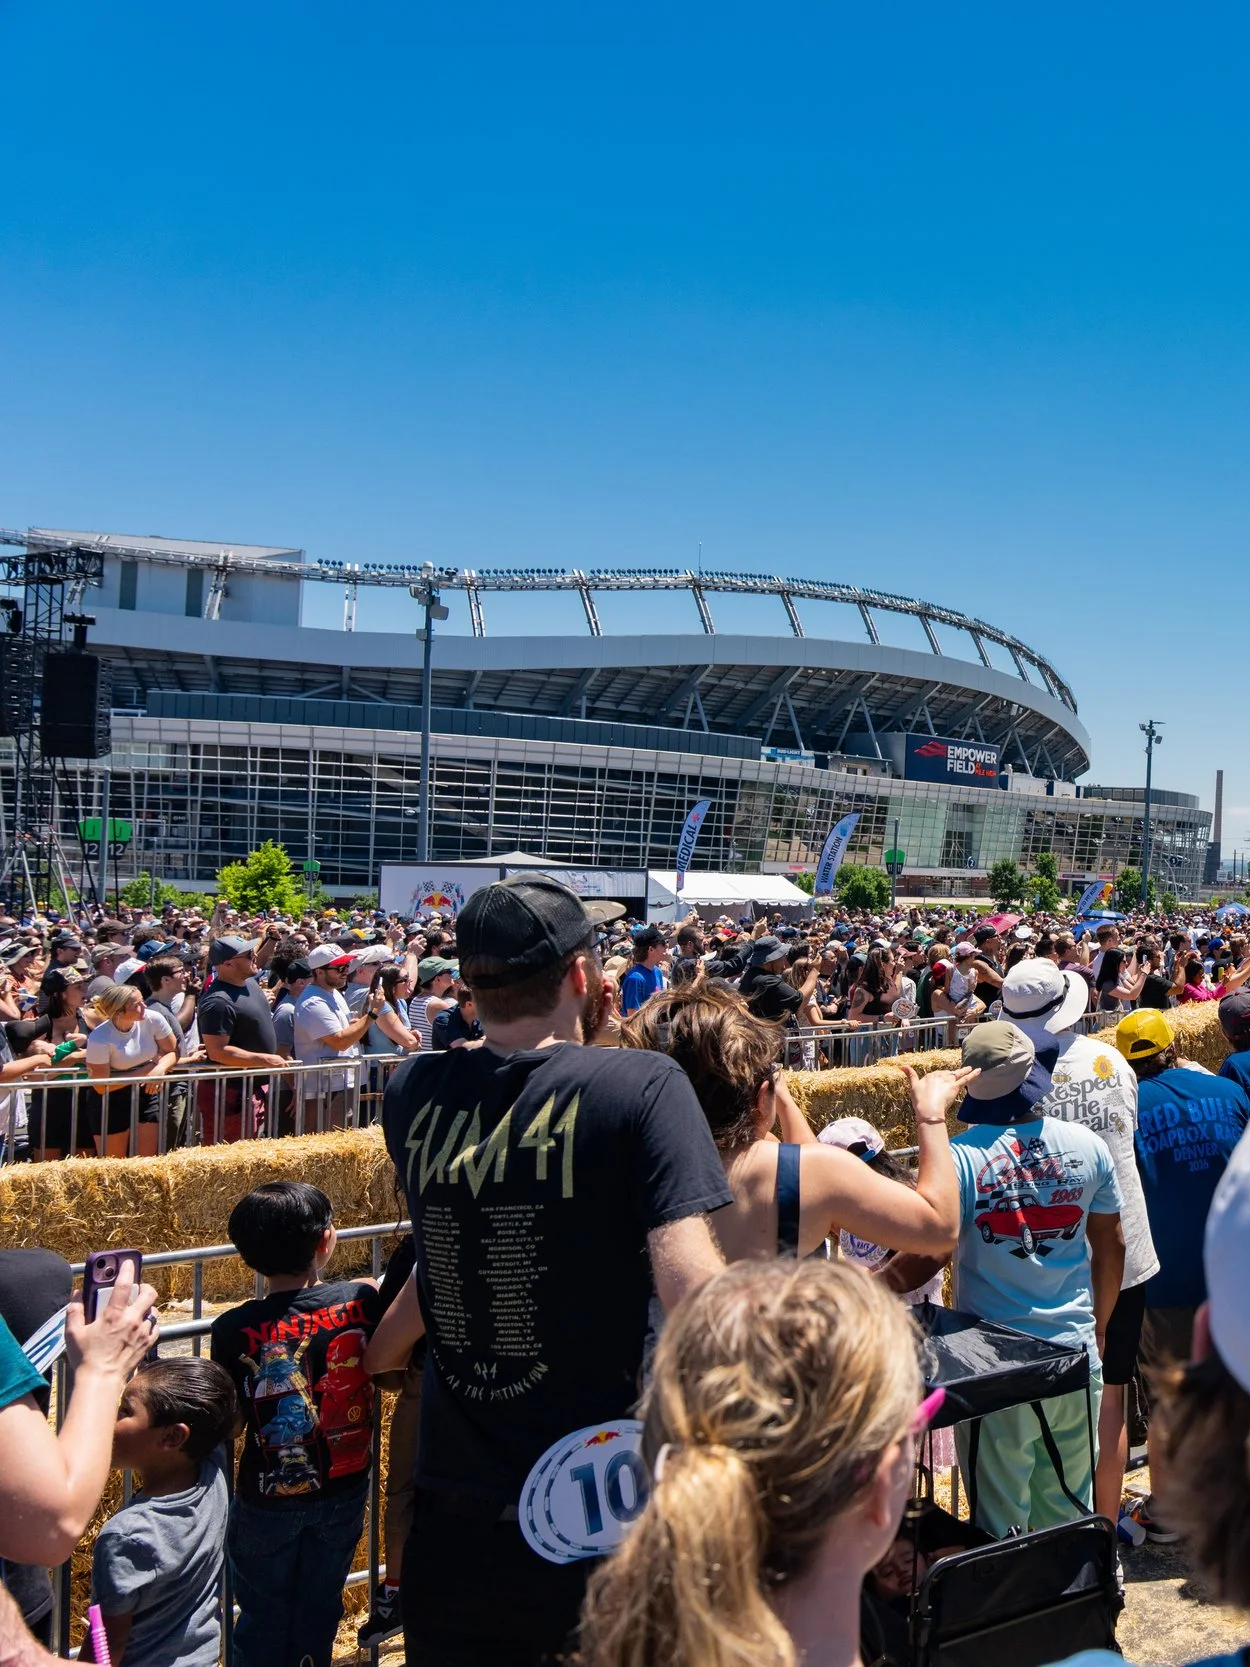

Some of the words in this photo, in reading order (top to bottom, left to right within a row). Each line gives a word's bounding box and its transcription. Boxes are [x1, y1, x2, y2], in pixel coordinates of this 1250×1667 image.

[946, 758, 976, 775] FIELD
[947, 745, 998, 765] EMPOWER
[84, 843, 99, 856] 12
[108, 843, 124, 856] 12
[677, 824, 698, 873] MEDICAL
[820, 860, 832, 884] WATER
[828, 836, 844, 863] STATION
[1049, 1098, 1101, 1122] The
[1139, 1102, 1180, 1138] RED
[405, 1095, 517, 1200] SUM
[518, 1088, 582, 1199] 41
[1137, 1123, 1210, 1157] SOAPBOX
[1173, 1142, 1219, 1162] DENVER
[1057, 1178, 1083, 1186] RAY
[856, 1240, 871, 1250] RACE
[240, 1301, 375, 1357] NINJAGO
[569, 1450, 651, 1536] 10
